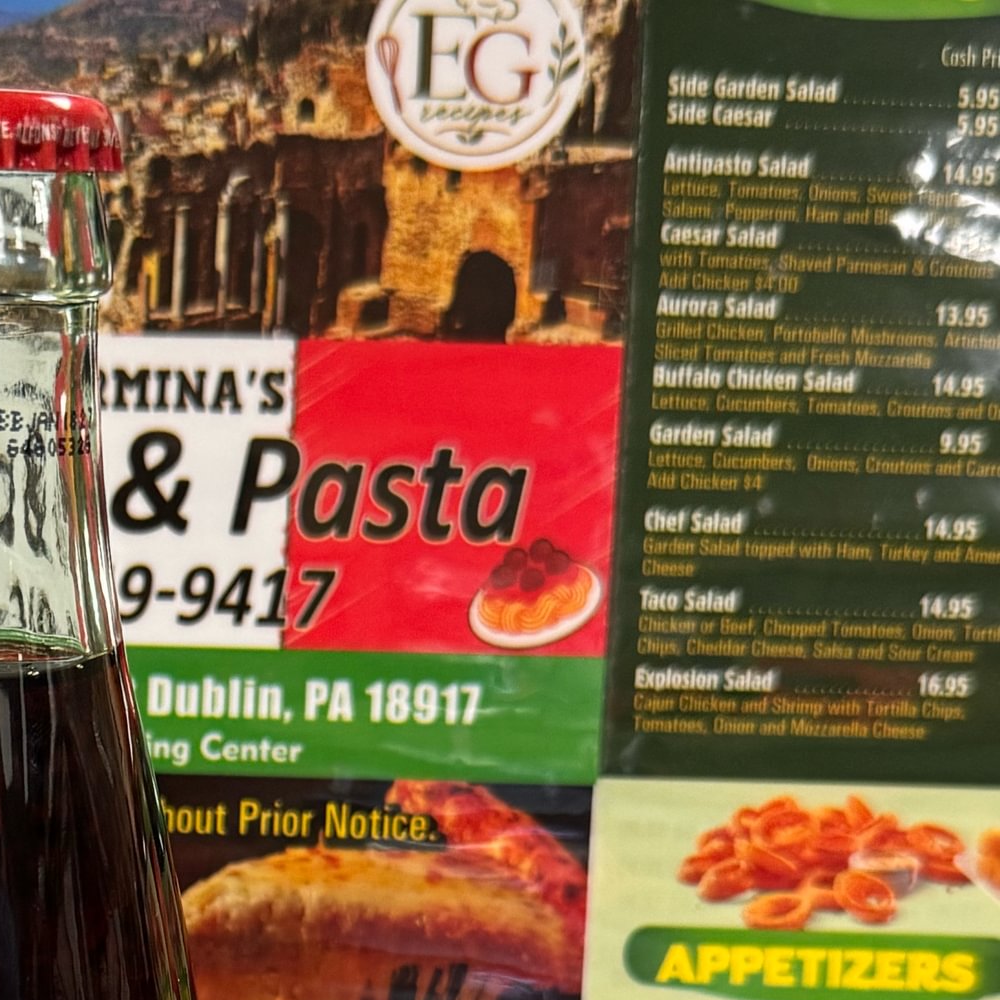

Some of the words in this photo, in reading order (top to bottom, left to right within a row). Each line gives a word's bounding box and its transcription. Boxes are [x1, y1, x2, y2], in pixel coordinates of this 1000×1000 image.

[667, 71, 709, 97] Side
[714, 72, 780, 100] Garden
[785, 75, 839, 103] Salad
[957, 83, 1000, 109] 5.95
[660, 222, 721, 246] Caesar
[726, 224, 779, 249] Salad
[652, 364, 721, 389] Buffalo
[726, 366, 797, 391] Chicken
[802, 368, 856, 393] Salad
[932, 372, 986, 398] 14.95
[650, 422, 716, 446] Garden
[721, 423, 774, 448] Salad
[939, 430, 983, 455] 9.95
[110, 431, 191, 535] &
[230, 437, 528, 545] Pasta
[644, 509, 686, 532] Chef
[691, 510, 744, 534] Salad
[119, 564, 338, 631] 9-9417
[147, 674, 292, 724] Dublin,
[304, 679, 354, 722] PA
[365, 681, 482, 725] 18917
[634, 666, 719, 691] Explosion
[723, 668, 774, 692] Salad
[917, 673, 969, 698] 16.95
[200, 732, 302, 764] Center
[238, 800, 315, 836] Prior
[323, 803, 438, 842] Notice.
[655, 943, 979, 993] APPETIZERS
